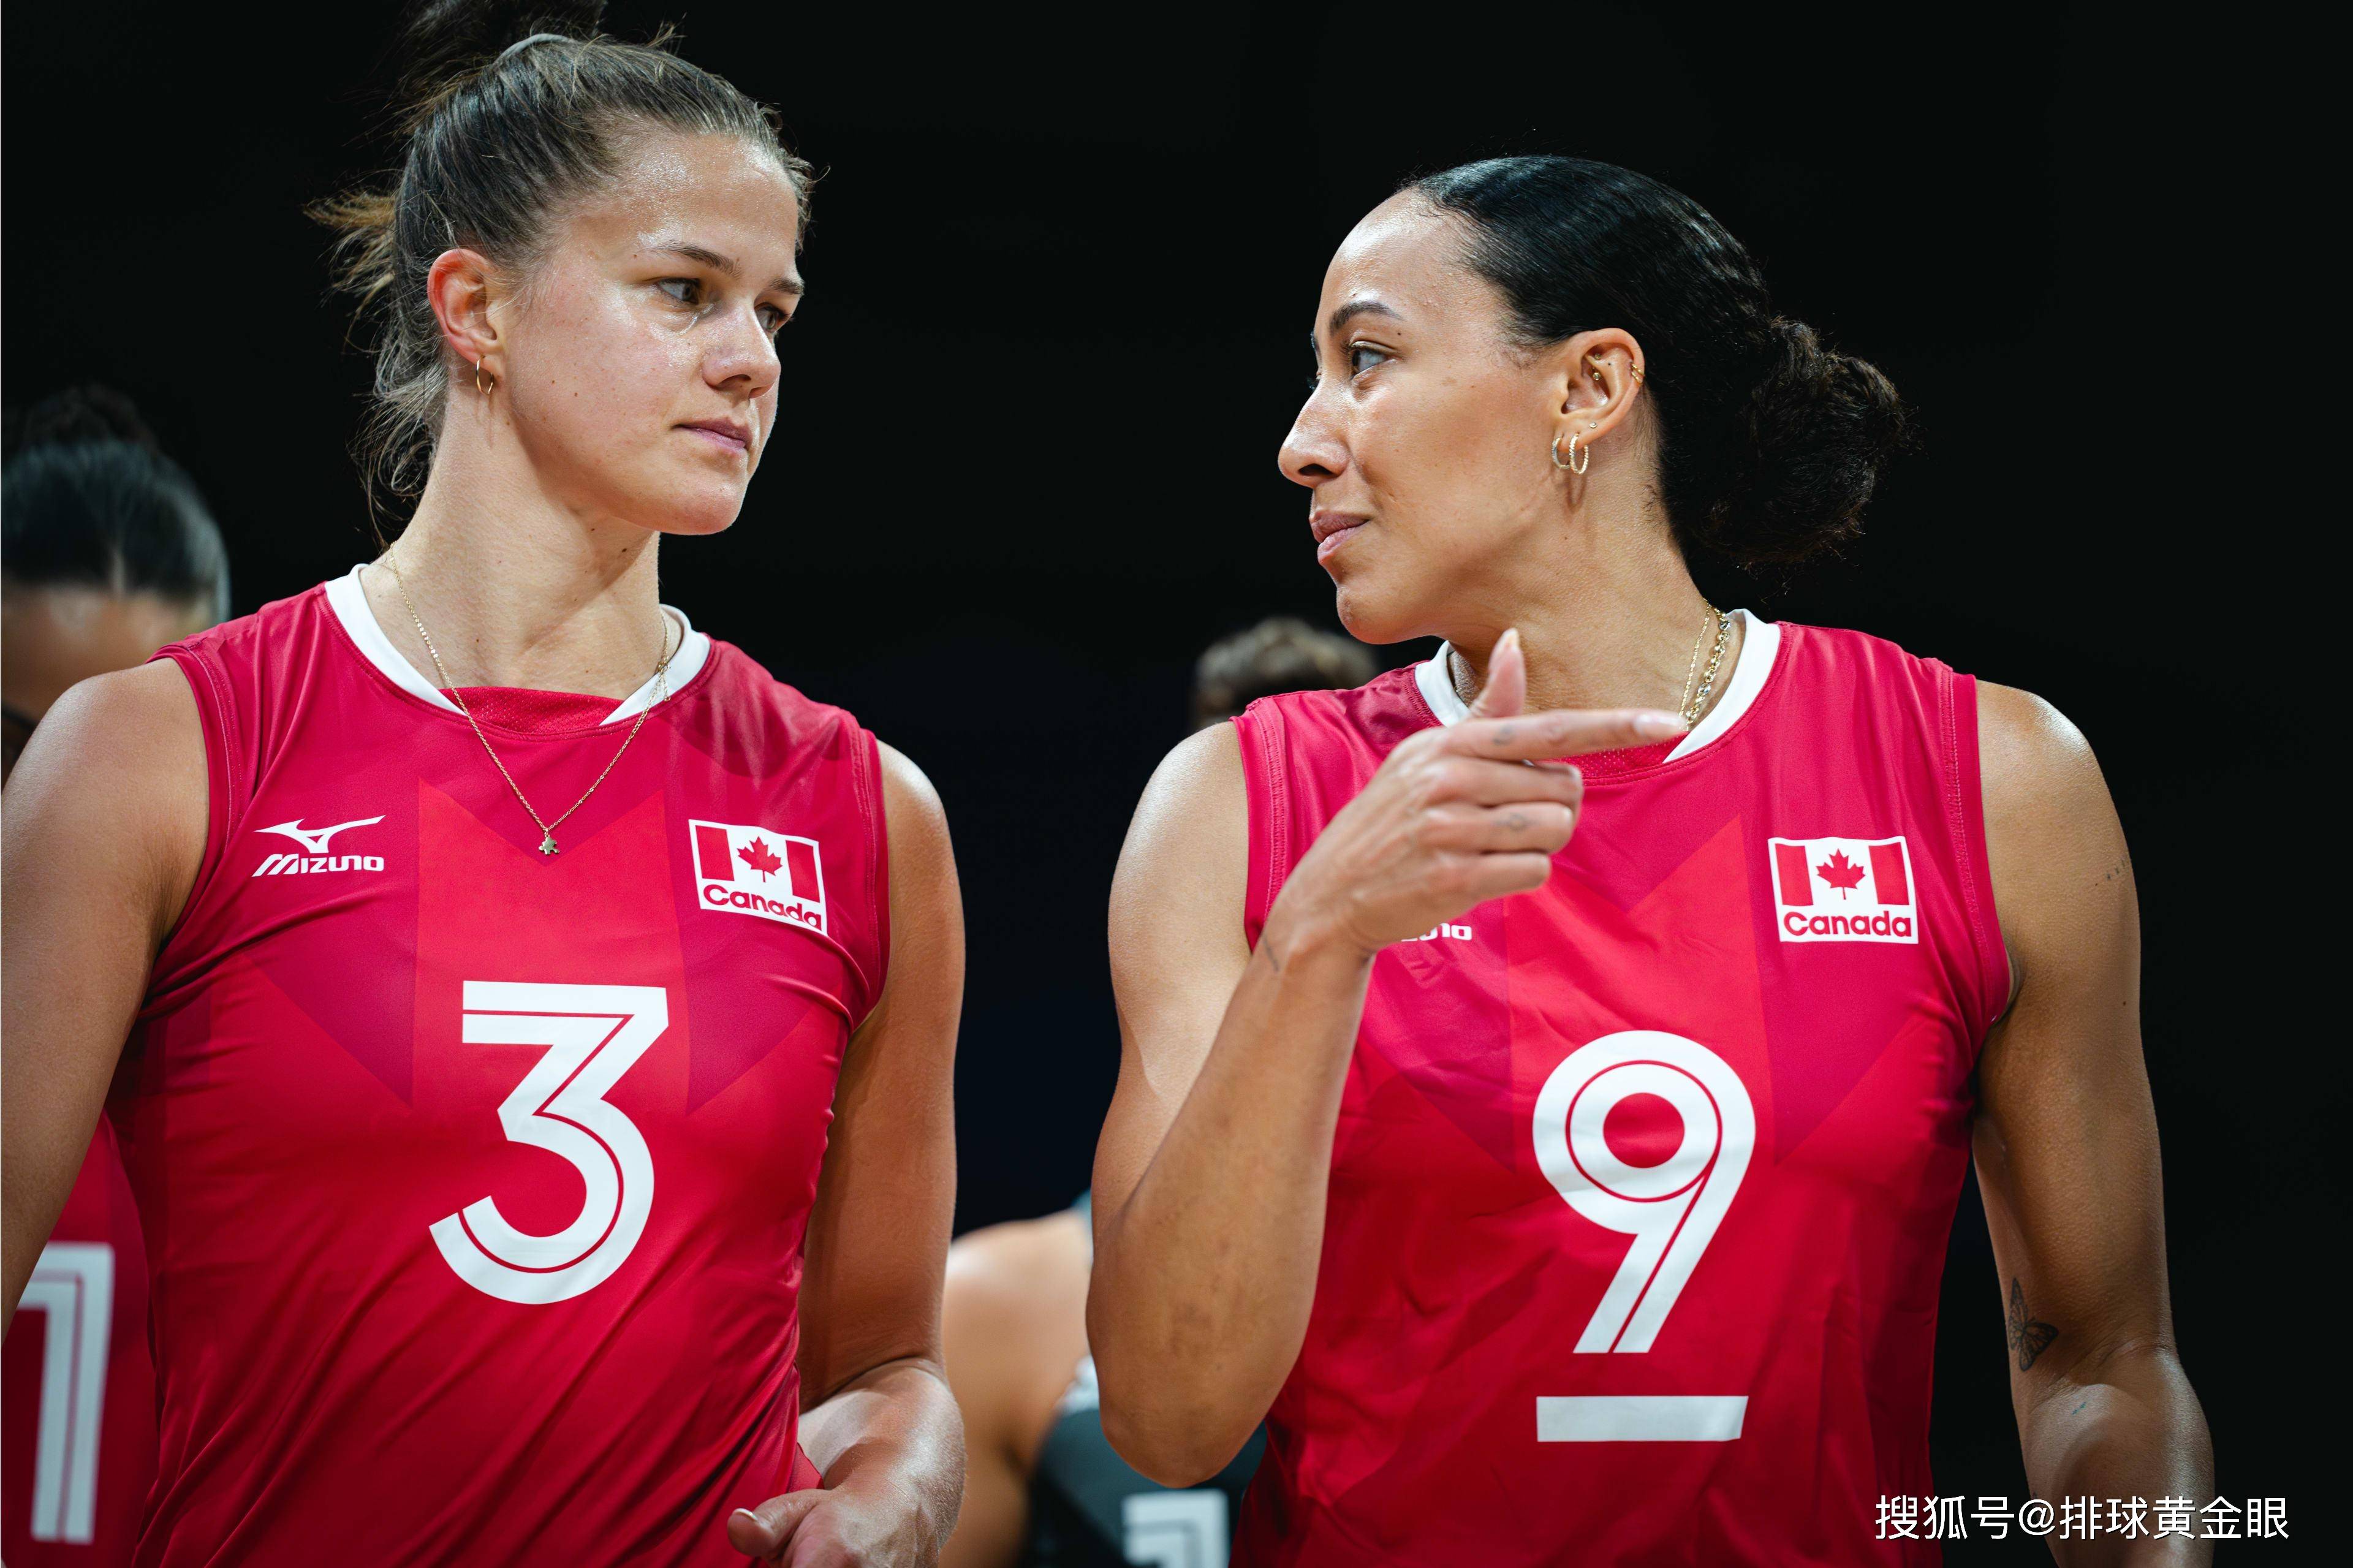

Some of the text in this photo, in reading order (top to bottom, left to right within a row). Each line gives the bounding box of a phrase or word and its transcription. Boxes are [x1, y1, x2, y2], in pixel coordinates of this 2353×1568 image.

[703, 884, 822, 931] Canada
[1784, 911, 1912, 937] Canada
[429, 980, 669, 1305] 3
[1533, 1030, 1756, 1354] 9
